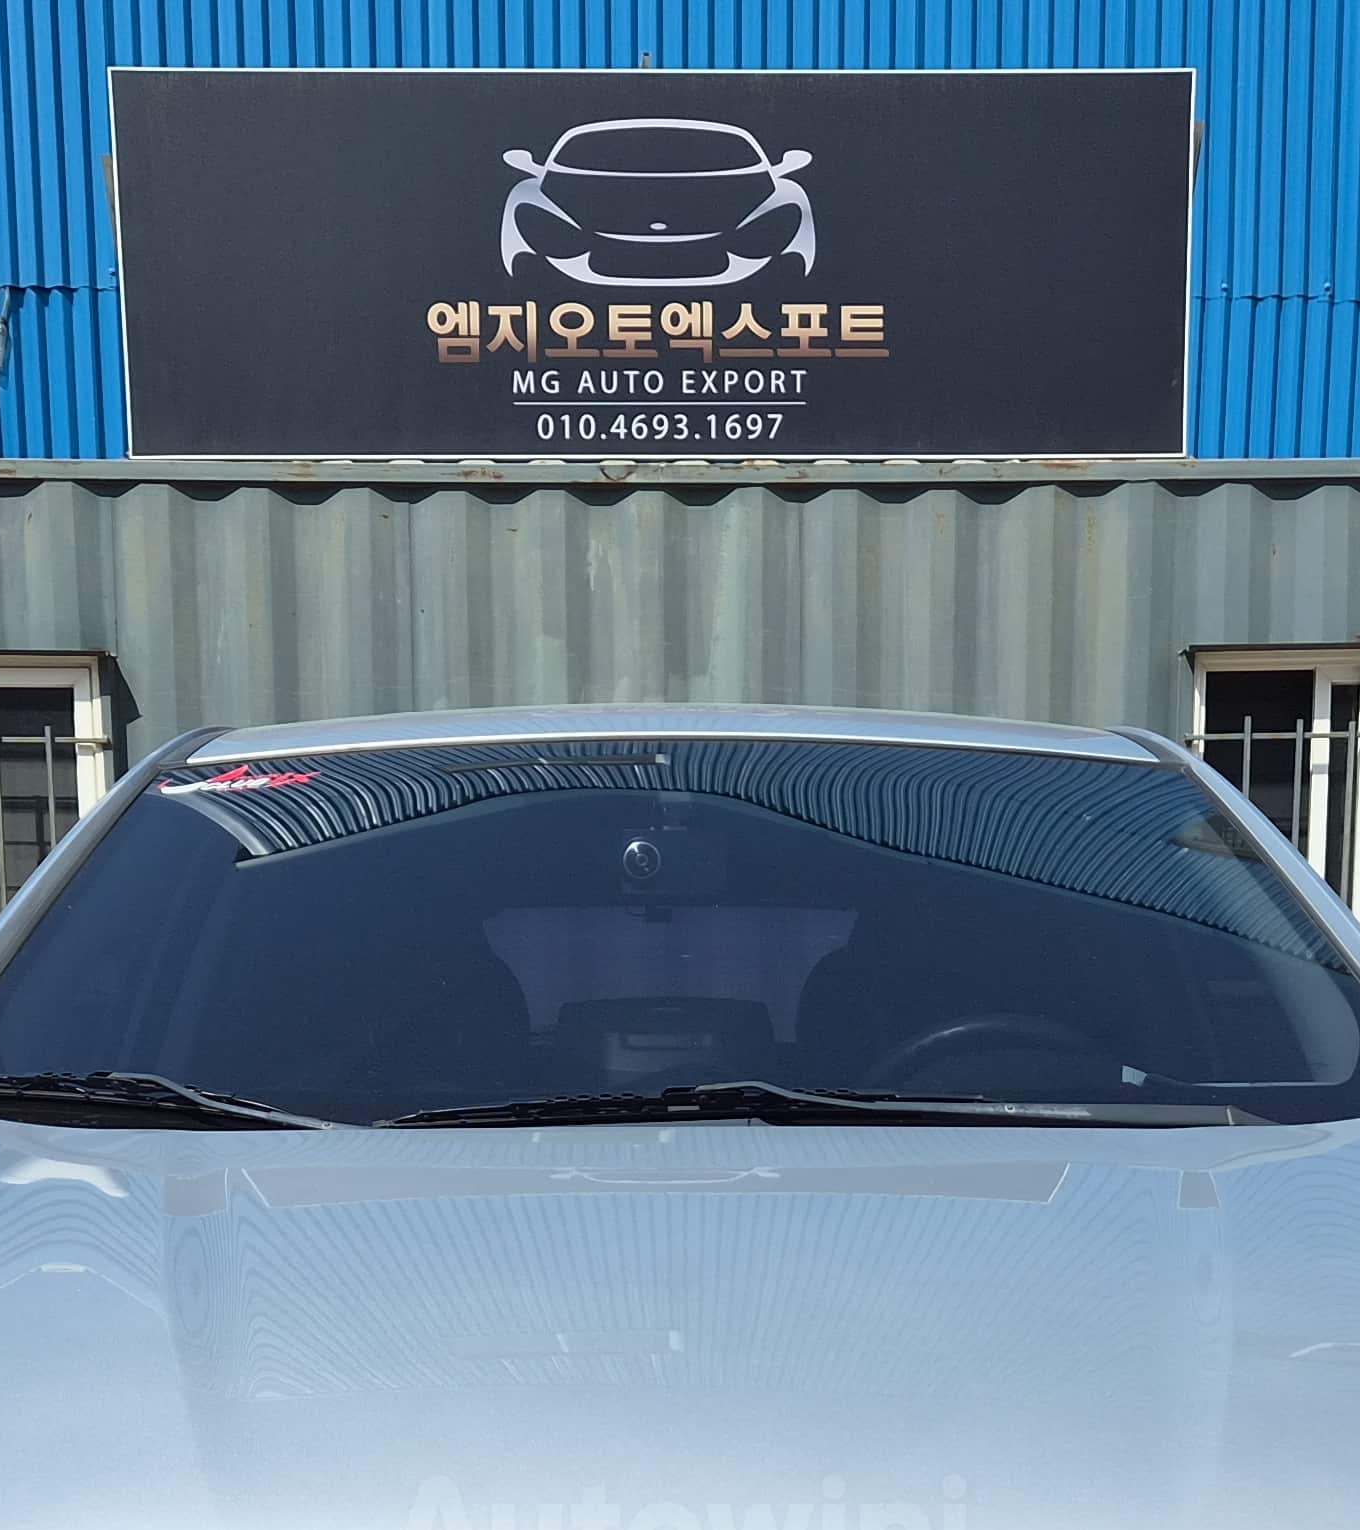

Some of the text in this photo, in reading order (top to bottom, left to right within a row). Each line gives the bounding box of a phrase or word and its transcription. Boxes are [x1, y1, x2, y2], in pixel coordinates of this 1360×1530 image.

[426, 300, 890, 364] 엠지오토엑스포트
[513, 370, 808, 395] MG AUTO EXPORT
[537, 413, 784, 441] 010.4693.1697
